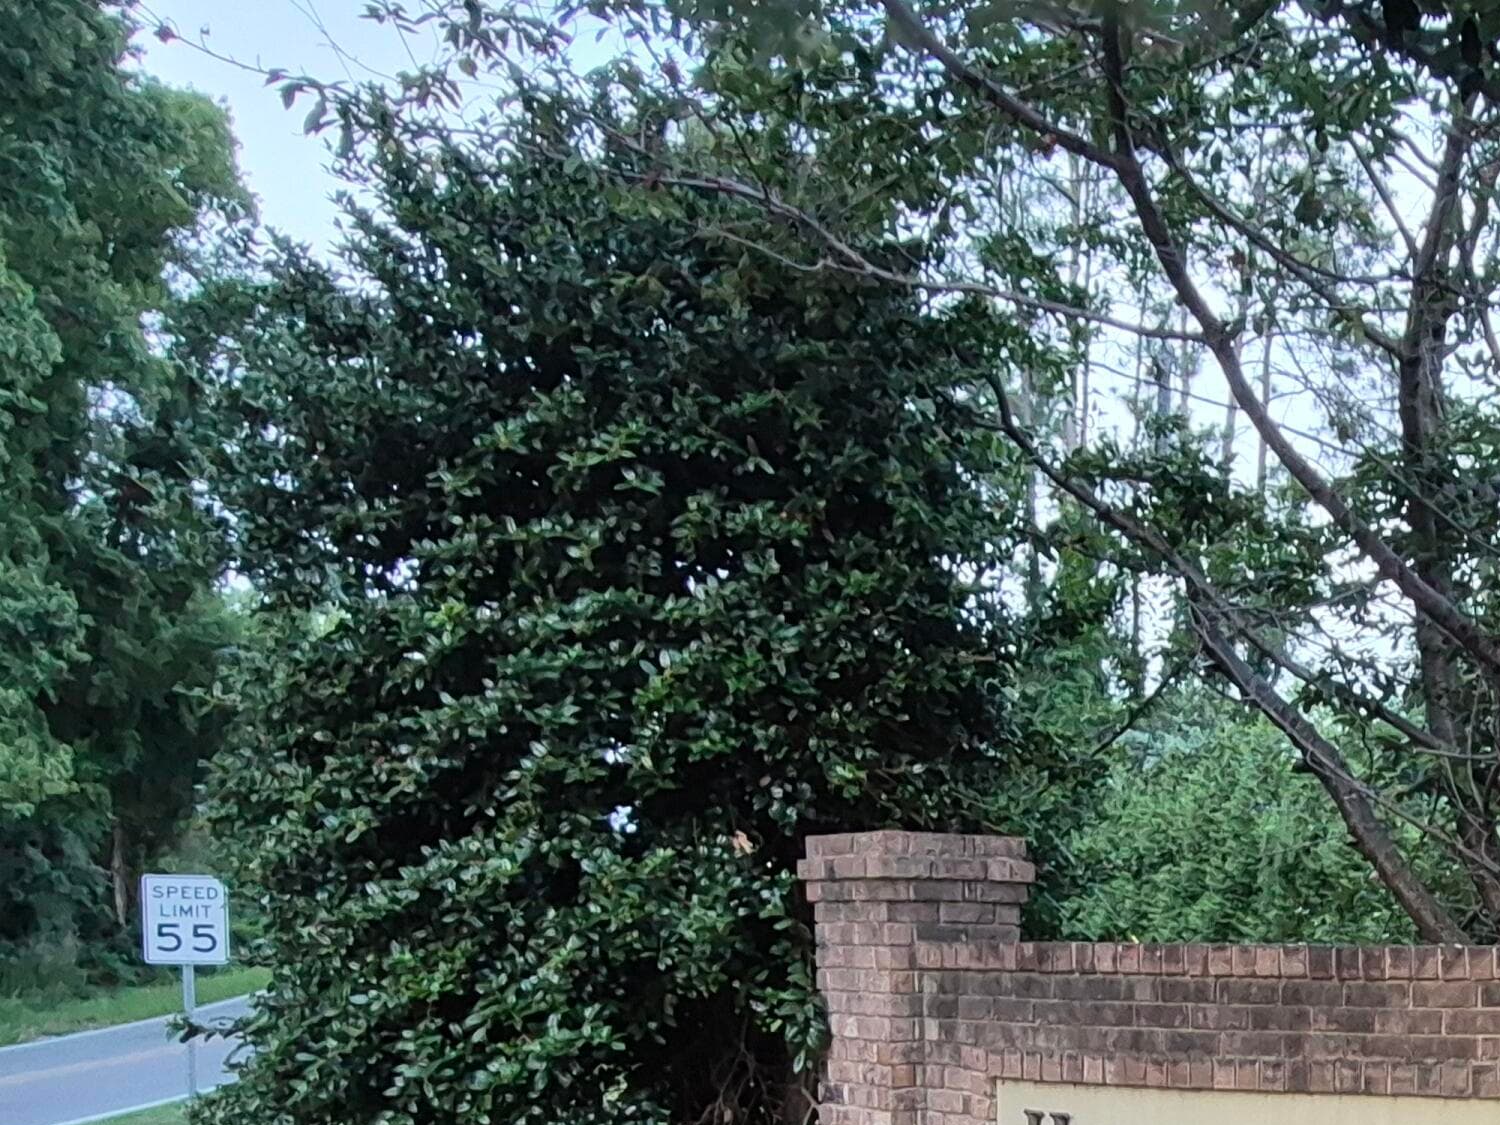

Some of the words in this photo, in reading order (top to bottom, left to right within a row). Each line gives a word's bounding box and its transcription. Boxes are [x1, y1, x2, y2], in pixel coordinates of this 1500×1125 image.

[152, 885, 218, 900] SPEED
[159, 903, 212, 919] LIMIT
[156, 923, 218, 953] 55
